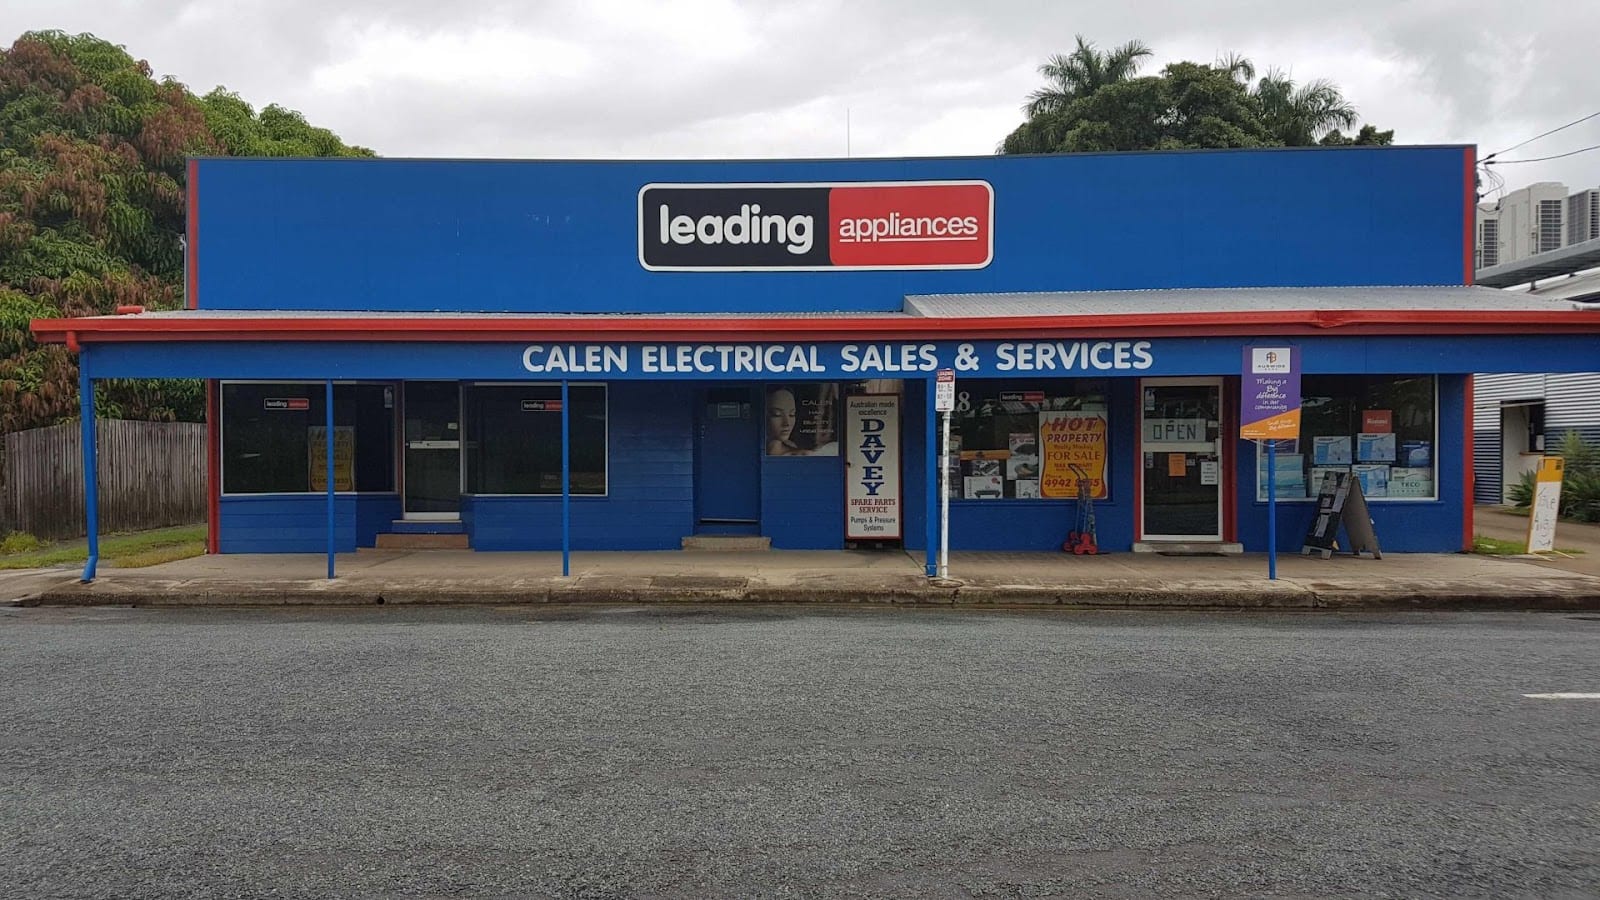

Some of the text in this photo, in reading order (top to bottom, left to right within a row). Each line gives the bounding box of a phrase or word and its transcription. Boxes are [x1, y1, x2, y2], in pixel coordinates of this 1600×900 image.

[660, 204, 978, 255] leading appliances
[522, 341, 1153, 373] CALEN ELECTRICAL SALES & SERVICES
[858, 408, 887, 416] excellence
[1051, 416, 1099, 432] HOT
[1153, 424, 1196, 440] OPEN
[1047, 433, 1102, 443] PROPERTY
[860, 418, 886, 496] DAVEY
[1047, 451, 1101, 461] FOR SALE
[851, 498, 896, 506] SPARE PARTS
[850, 516, 868, 524] Pumps
[863, 524, 885, 532] Systems
